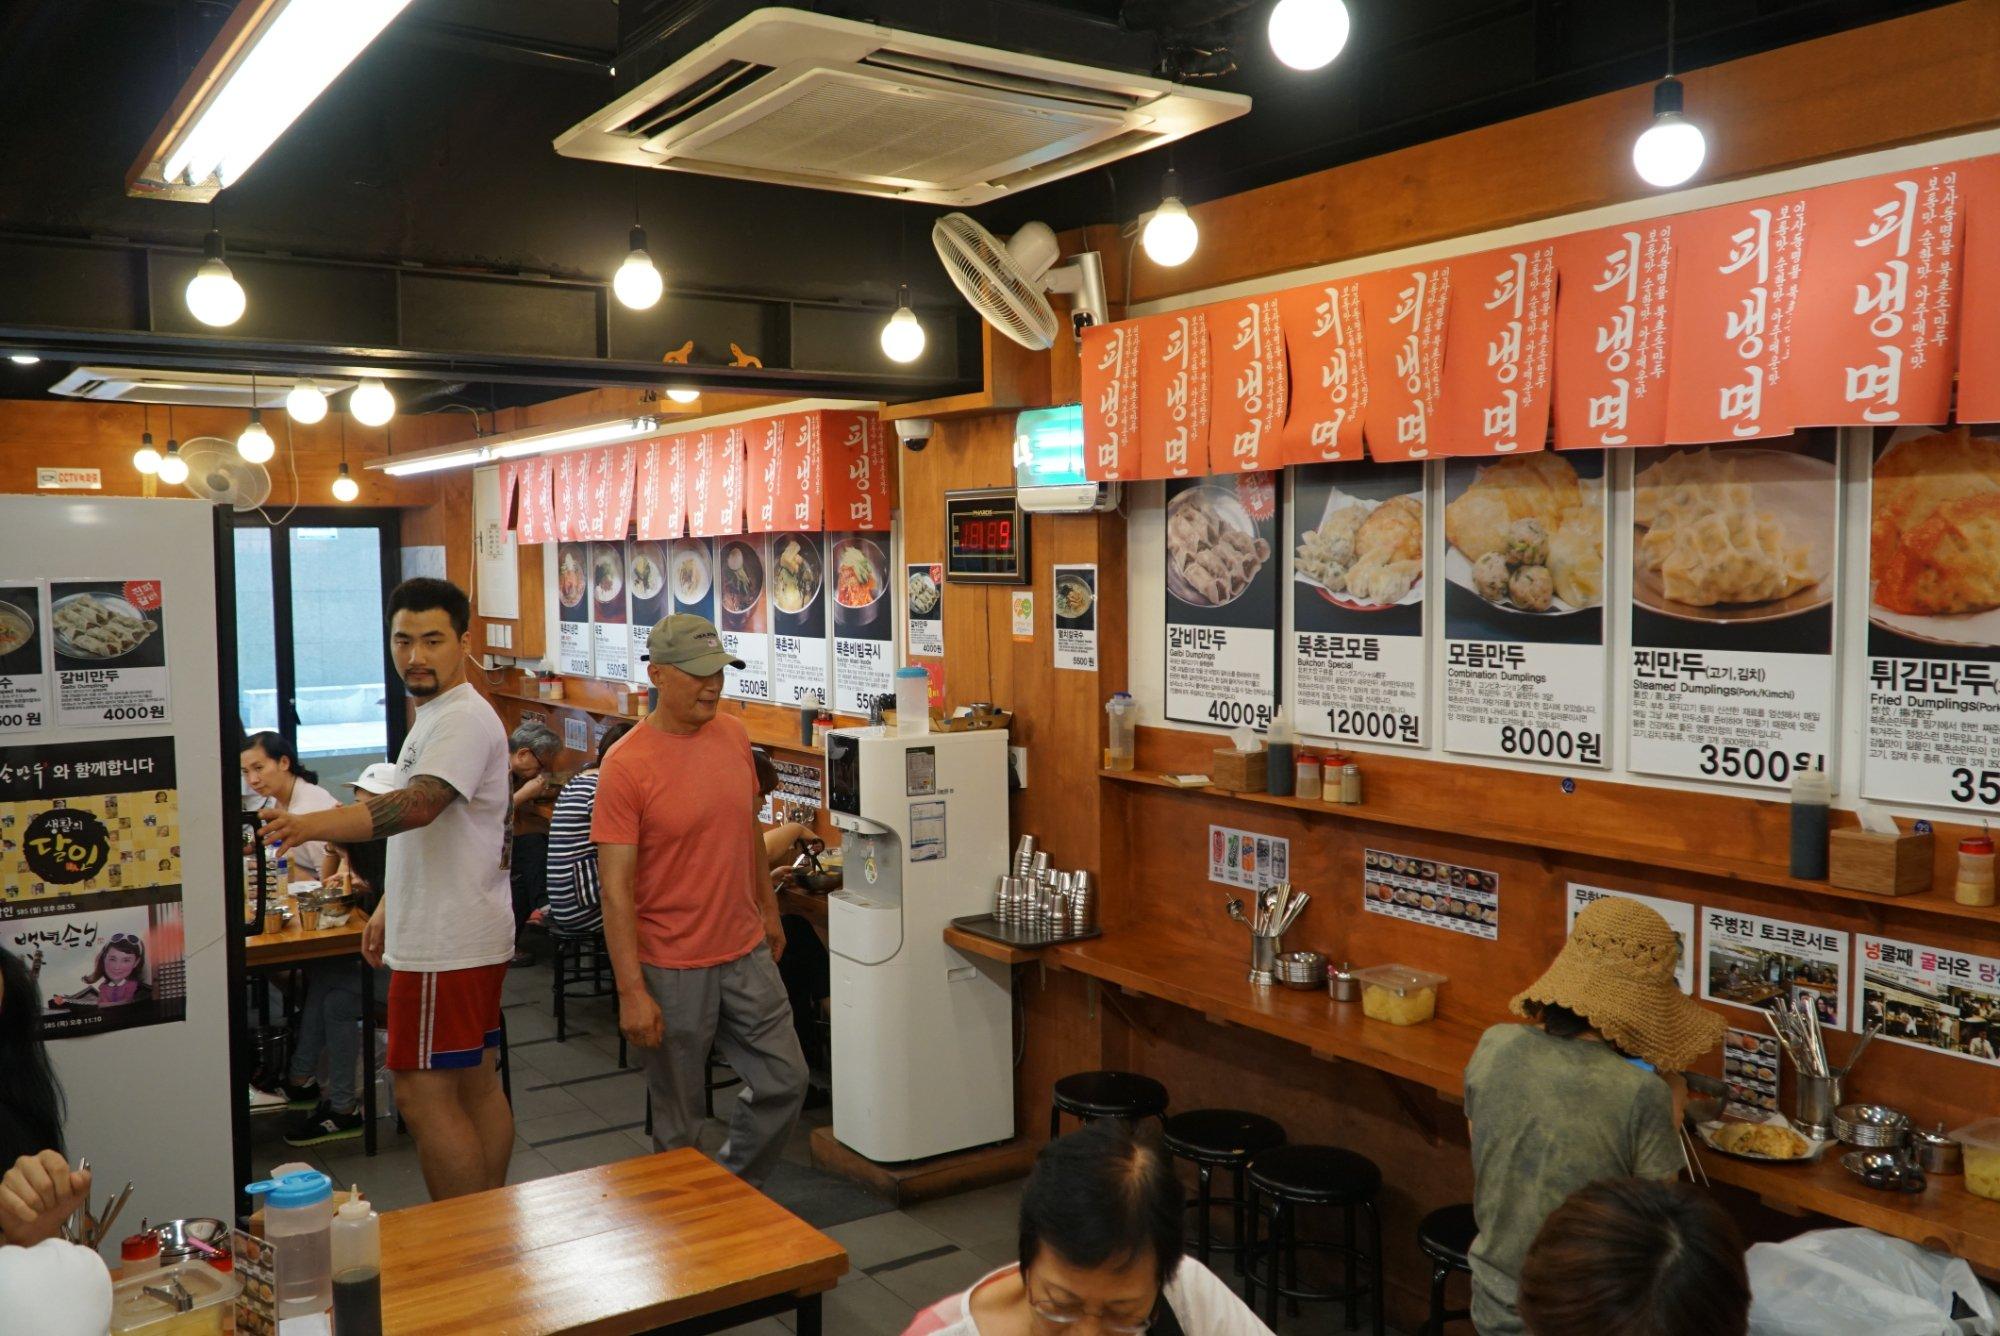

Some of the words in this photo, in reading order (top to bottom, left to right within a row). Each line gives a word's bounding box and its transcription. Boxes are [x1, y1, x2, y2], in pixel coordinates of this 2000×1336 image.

[1923, 176, 1939, 225] 보통맛
[1937, 171, 1959, 256] 인사동명물
[1644, 229, 1658, 273] 보통맛
[1776, 206, 1791, 252] 보통맛
[1788, 201, 1807, 279] 인사동명물
[1655, 225, 1672, 300] 인사동명물
[1917, 229, 1935, 279] 순한맛
[1639, 277, 1654, 322] 순한맛
[1772, 256, 1788, 304] 순한맛
[1844, 180, 1919, 422] 피냉면
[1719, 209, 1772, 437] 피냉면
[1930, 260, 1953, 347] 북촌손만두
[1589, 232, 1641, 445] 피냉면
[1650, 304, 1667, 379] 북촌손만두
[1910, 285, 1930, 369] 아주매운맛
[1310, 287, 1348, 459] 피냉면
[1389, 271, 1429, 458] 피냉면
[1483, 252, 1527, 451] 피냉면
[1098, 328, 1124, 479] 피냉면
[1162, 316, 1189, 476] 피냉면
[1233, 302, 1263, 470] 피냉면
[722, 428, 735, 533] 피냉면
[762, 421, 777, 529] 피냉면
[796, 416, 810, 529] 피냉면
[844, 416, 874, 529] 피냉면
[775, 634, 801, 653] 북촌국시
[836, 641, 881, 659] 북촌비빔국시
[923, 644, 942, 653] 4000원
[1169, 627, 1227, 650] 갈비만두
[1169, 648, 1184, 657] Galbi
[1186, 650, 1216, 660] Dumplings
[1297, 635, 1380, 661] 북촌큰모듬
[1448, 643, 1526, 670] 모듬만두
[60, 670, 119, 685] 갈비만두
[1297, 658, 1325, 667] Bukchon
[1328, 660, 1354, 669] Special
[1448, 668, 1498, 679] Combination
[1501, 671, 1547, 684] Dumplings
[1633, 679, 1677, 692] Steamed
[740, 679, 768, 697] 5500원
[1870, 693, 1903, 706] Fried
[104, 706, 164, 721] 4000원
[1208, 700, 1272, 731] 4000원
[1327, 708, 1420, 743] 12000원
[1501, 726, 1602, 764] 8000원
[53, 764, 70, 780] 와
[74, 757, 155, 778] 함께합니다
[1951, 767, 2000, 805] 35
[45, 817, 83, 834] 생활의
[29, 833, 98, 864] 달인
[14, 921, 98, 949] 백년손님
[1709, 912, 1754, 938] 주병진
[1760, 927, 1840, 953] 토크콘서트
[1864, 940, 1913, 967] 넝쿨째
[1919, 951, 1971, 978] 굴러온
[1979, 963, 2000, 983] 당
